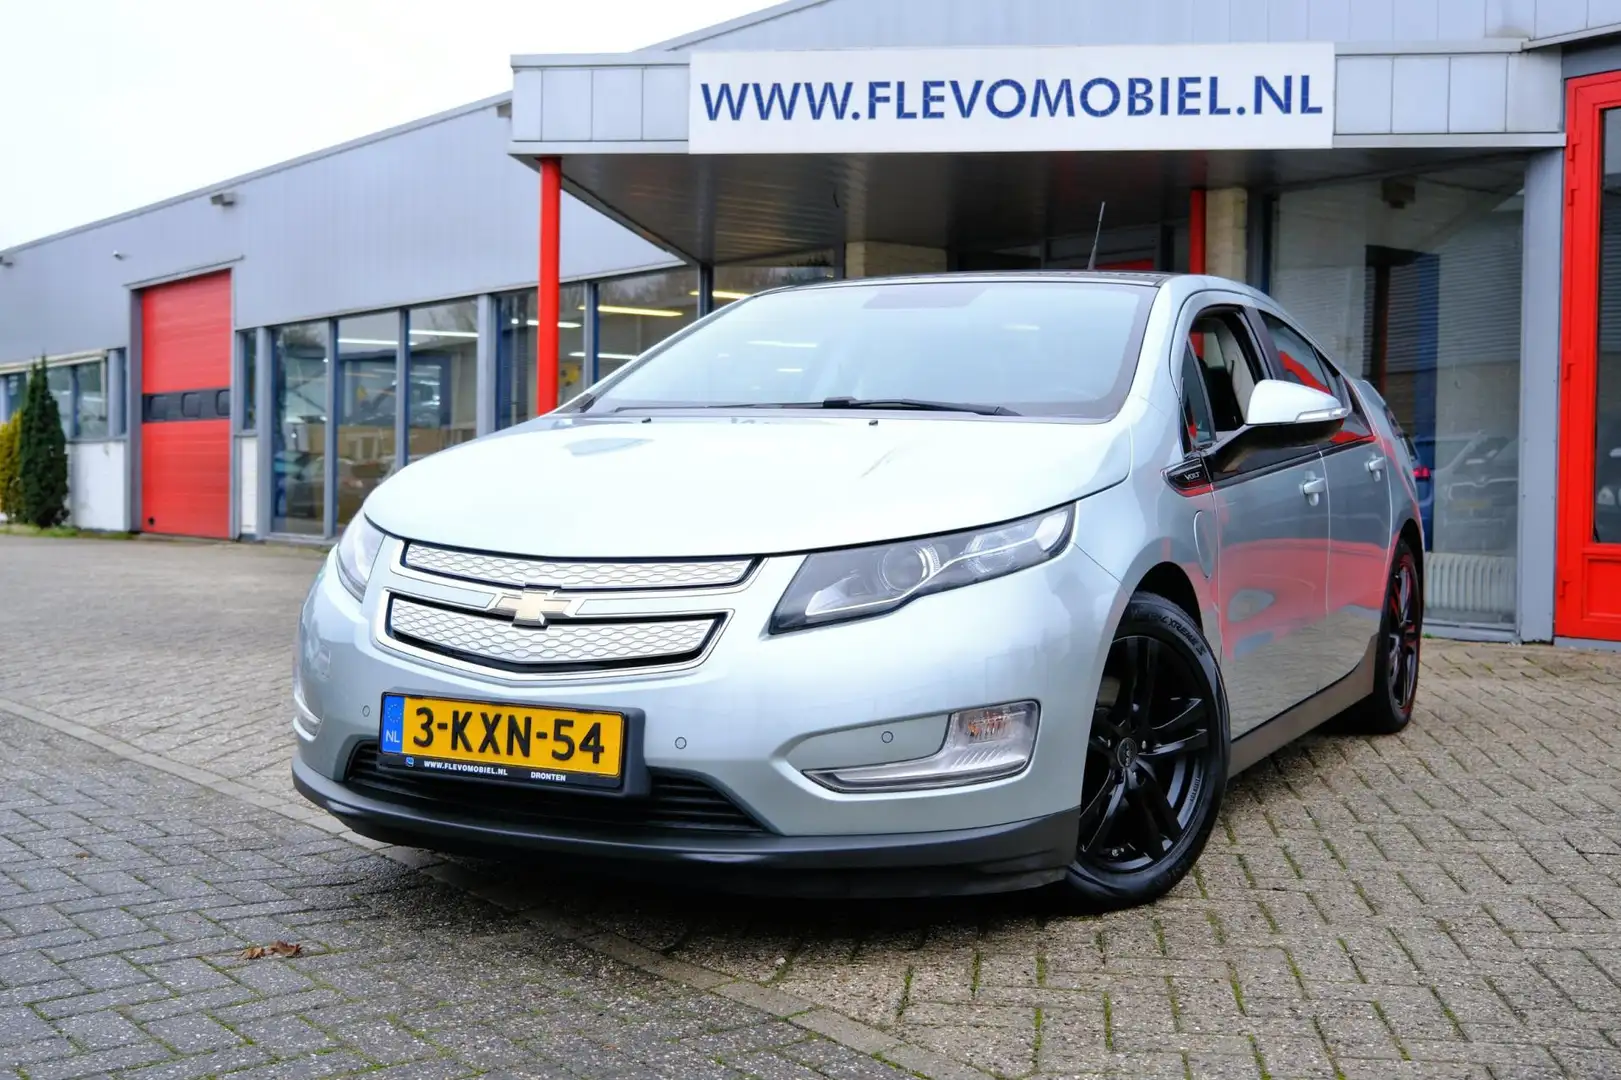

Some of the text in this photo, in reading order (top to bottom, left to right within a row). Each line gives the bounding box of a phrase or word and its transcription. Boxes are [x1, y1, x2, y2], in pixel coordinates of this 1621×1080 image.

[700, 75, 1323, 121] WWW.FLEVOMOBIEL.NL
[1184, 472, 1201, 480] VOLT
[385, 729, 401, 743] NL
[412, 706, 605, 765] 3-KXN-54
[423, 760, 567, 782] WWW.FLEVOMOBIEL.NL DRONTEN
